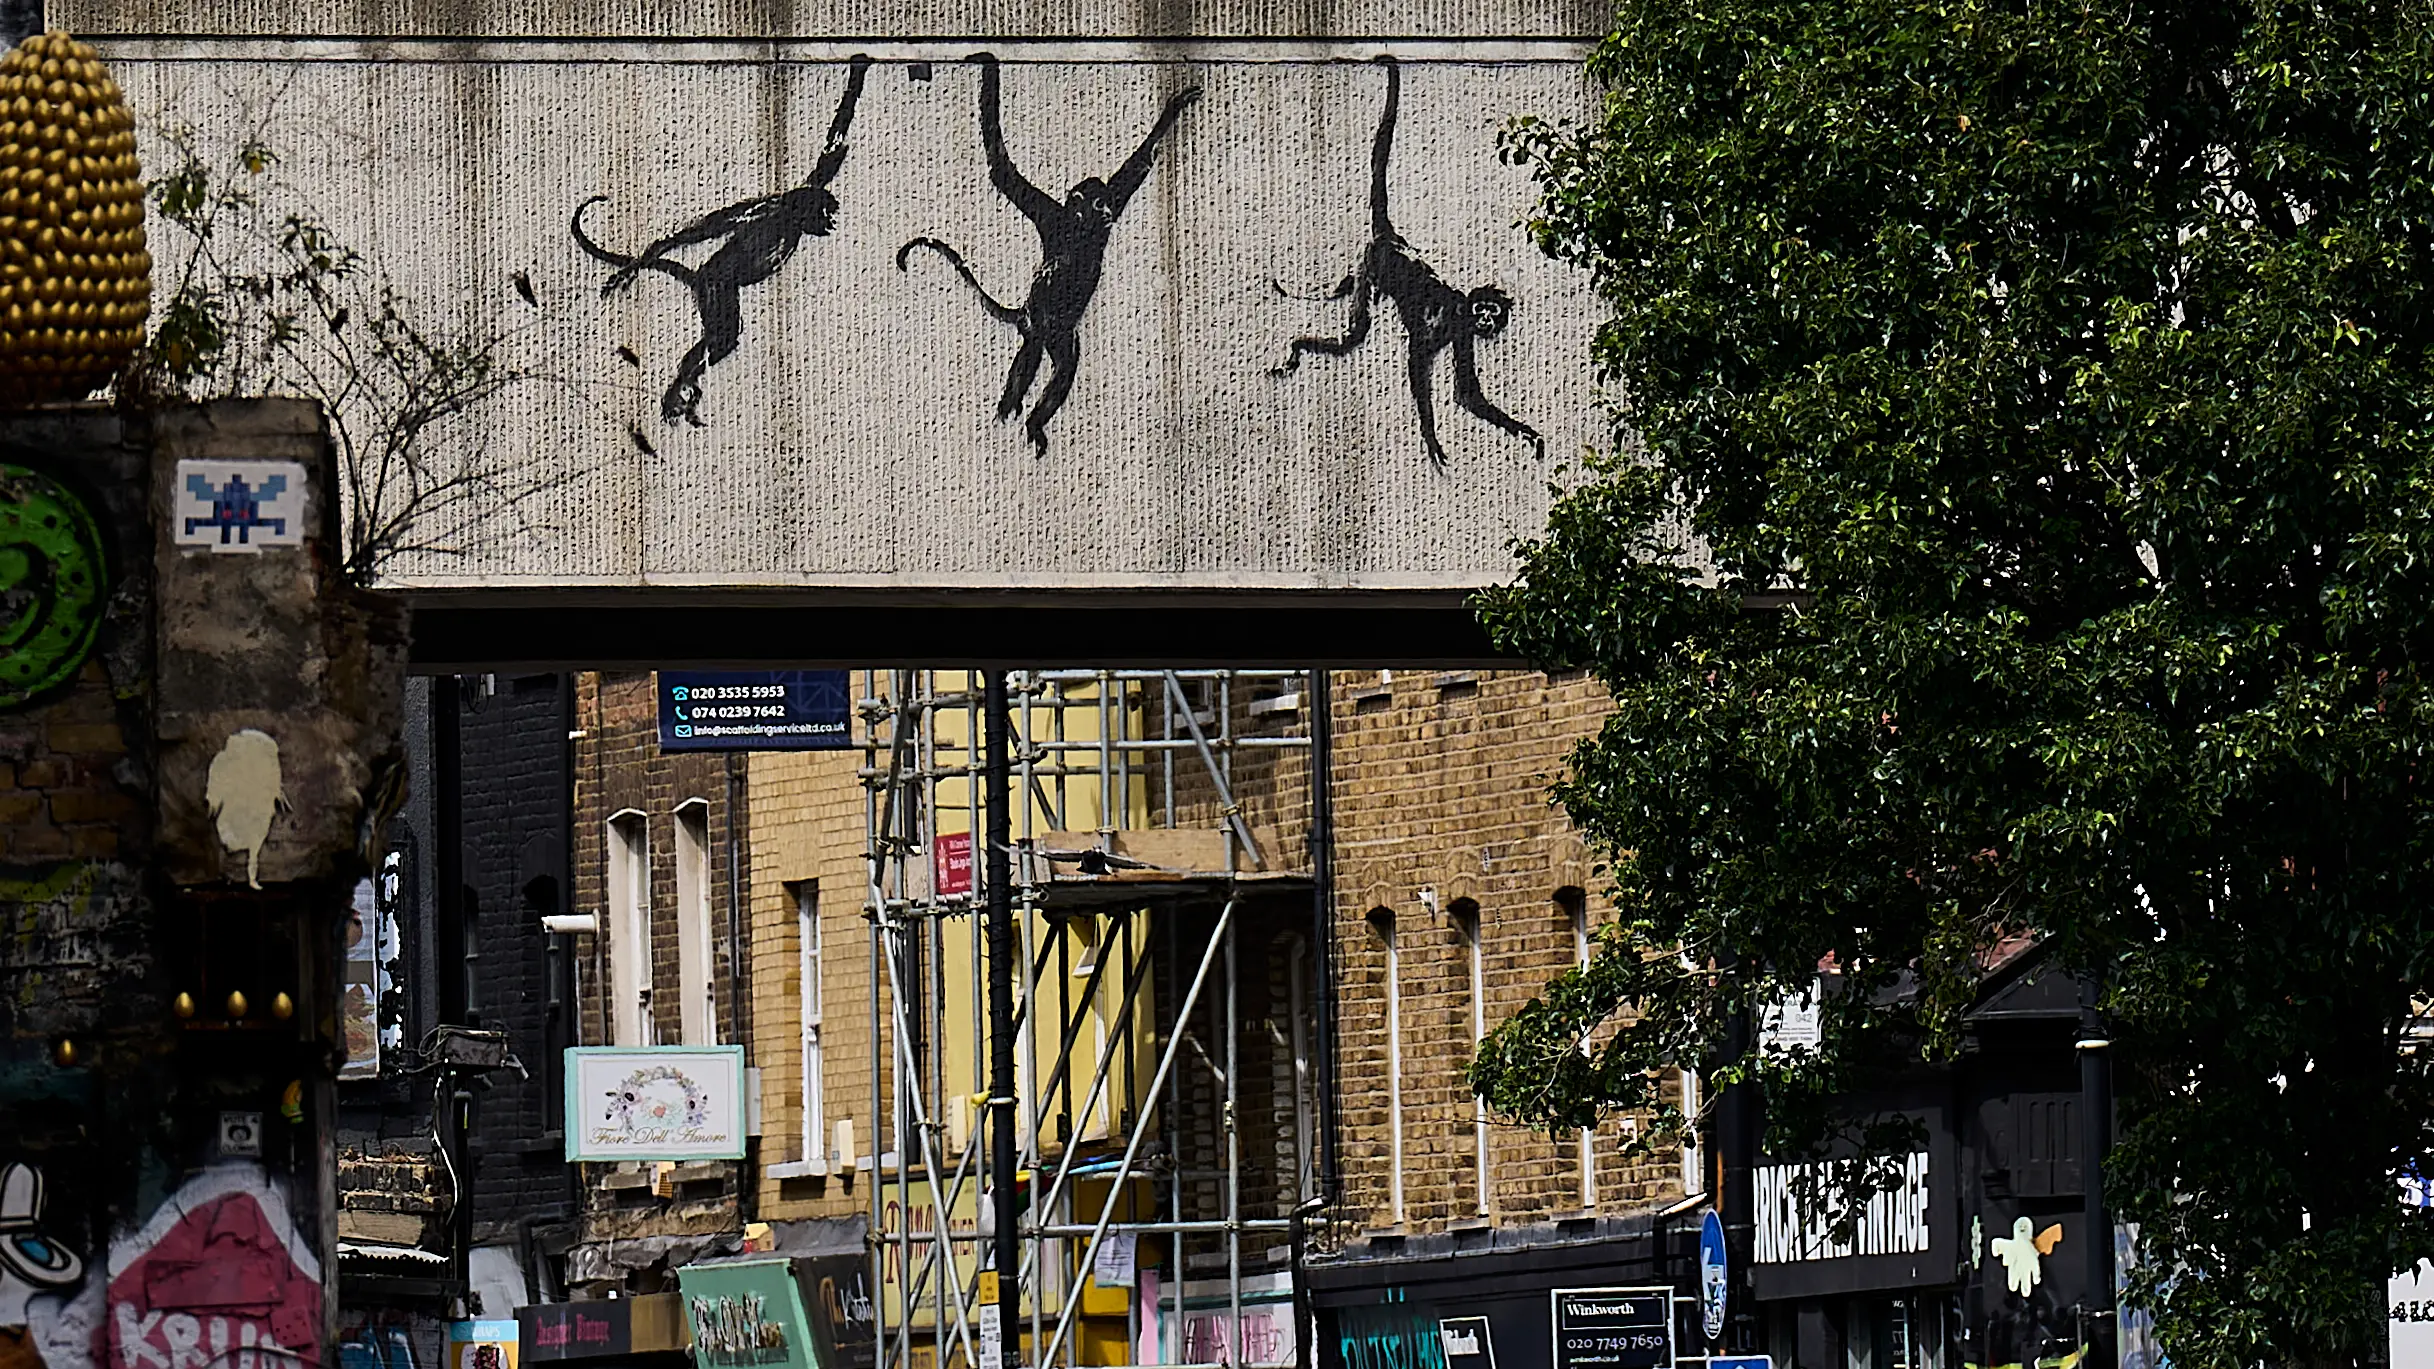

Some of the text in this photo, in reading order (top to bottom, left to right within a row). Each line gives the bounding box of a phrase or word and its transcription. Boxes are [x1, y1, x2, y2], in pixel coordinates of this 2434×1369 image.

[691, 685, 785, 700] 020 3535 5953
[692, 705, 785, 719] 074 0239 7642
[589, 1126, 631, 1145] Fiore
[671, 1126, 727, 1144] Amore
[1566, 1302, 1635, 1316] Winkworth
[1566, 1333, 1663, 1350] 020 7749 7650
